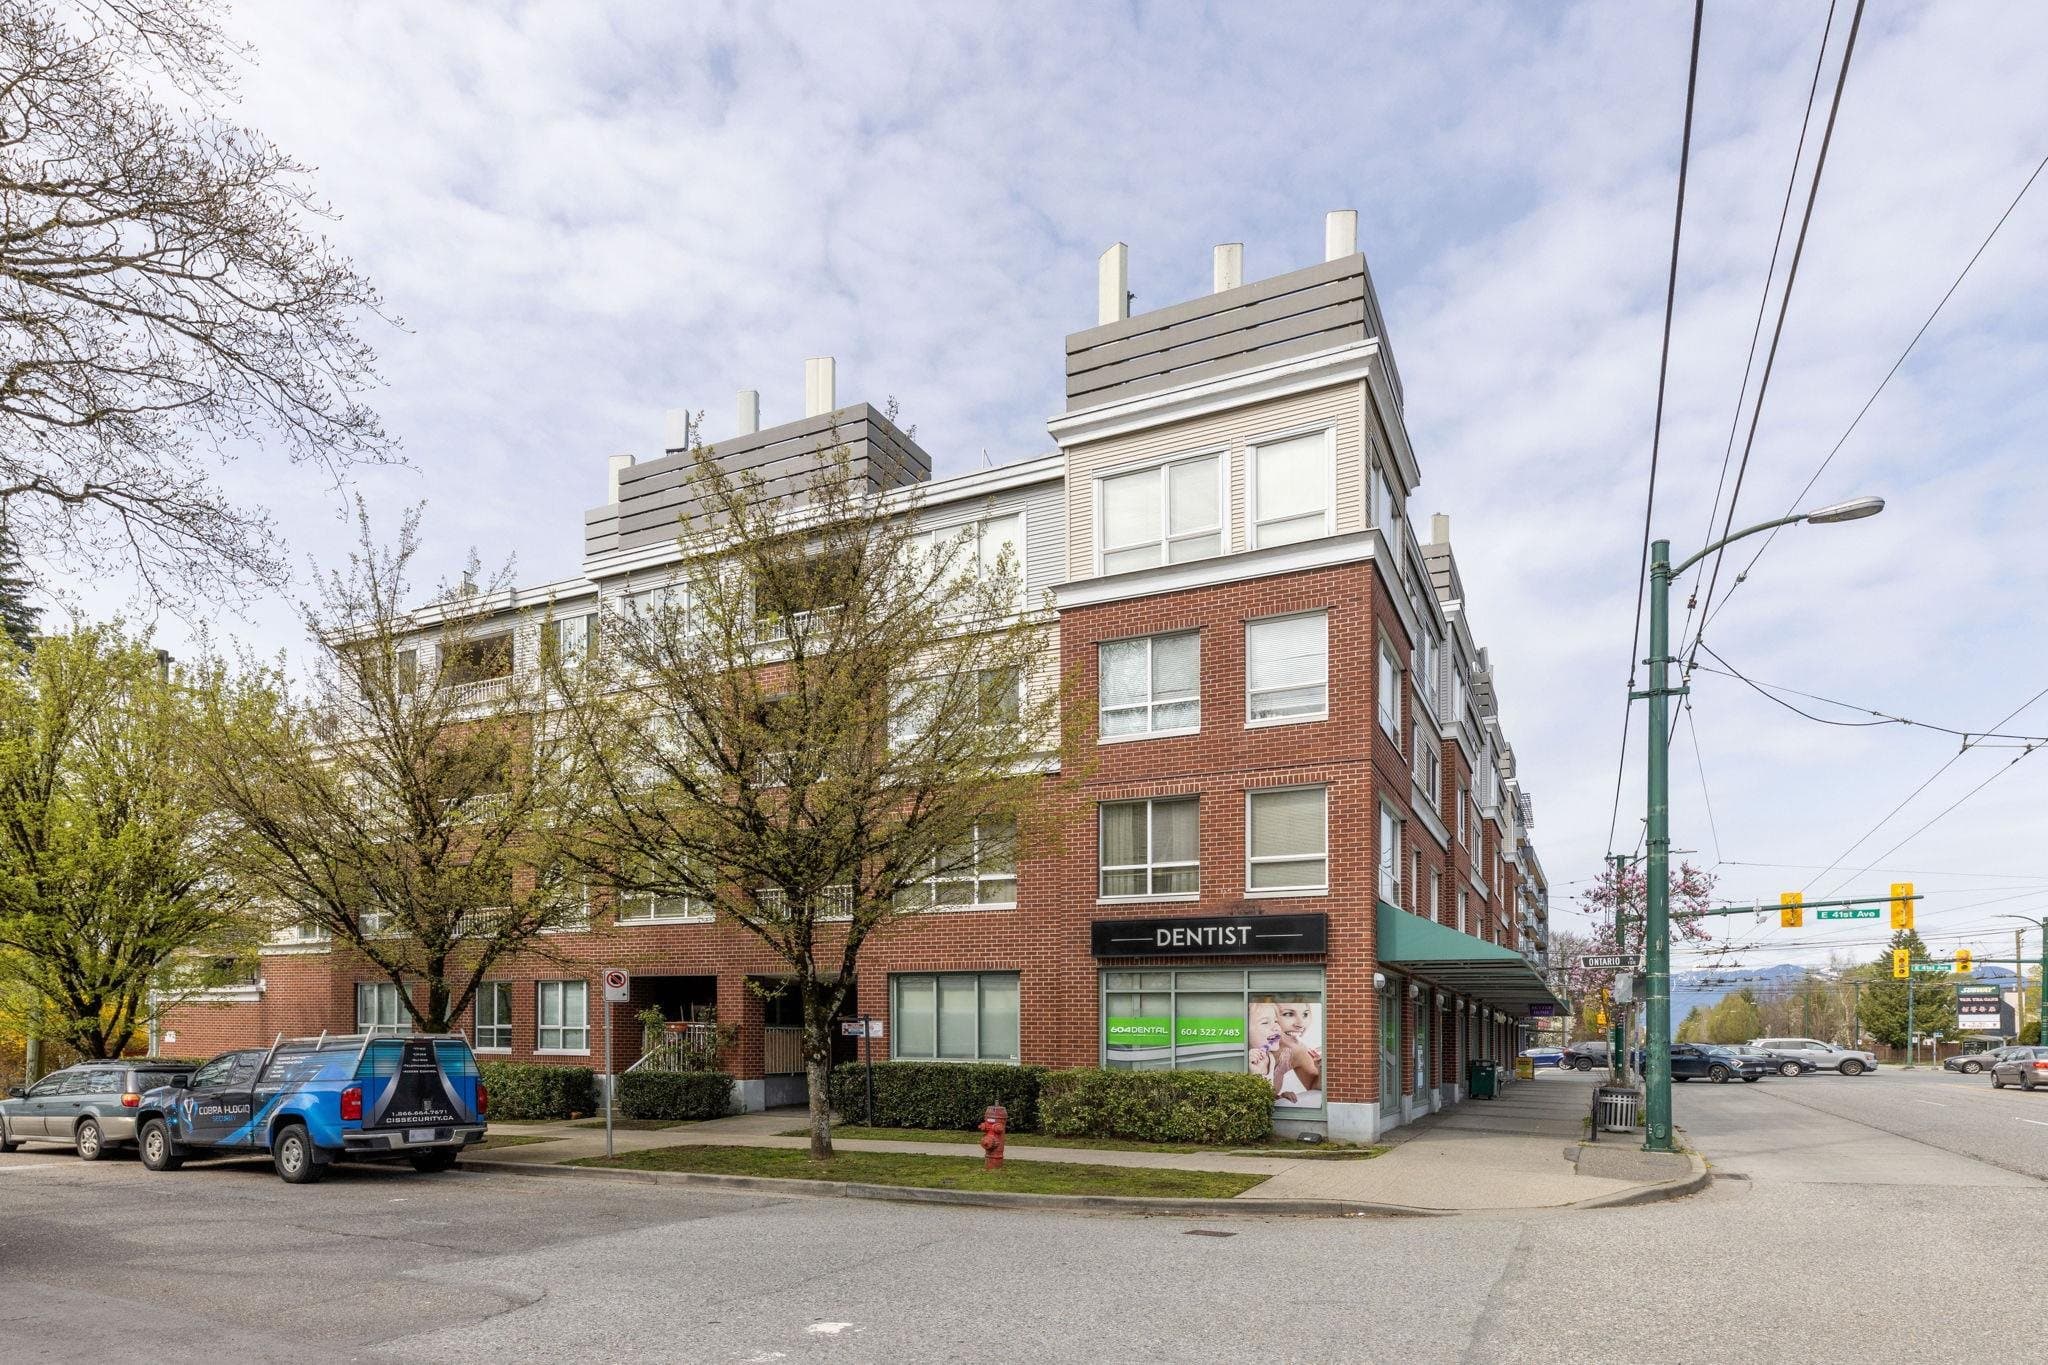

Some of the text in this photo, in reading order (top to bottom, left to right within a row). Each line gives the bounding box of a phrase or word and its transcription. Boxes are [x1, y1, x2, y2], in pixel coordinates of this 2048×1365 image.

[1157, 926, 1252, 946] DENTIST
[1588, 957, 1621, 966] ONTARIO
[1181, 1028, 1240, 1037] 604 322 7483
[198, 1105, 223, 1115] COBRA
[386, 1115, 454, 1123] CISSECURITY.CA
